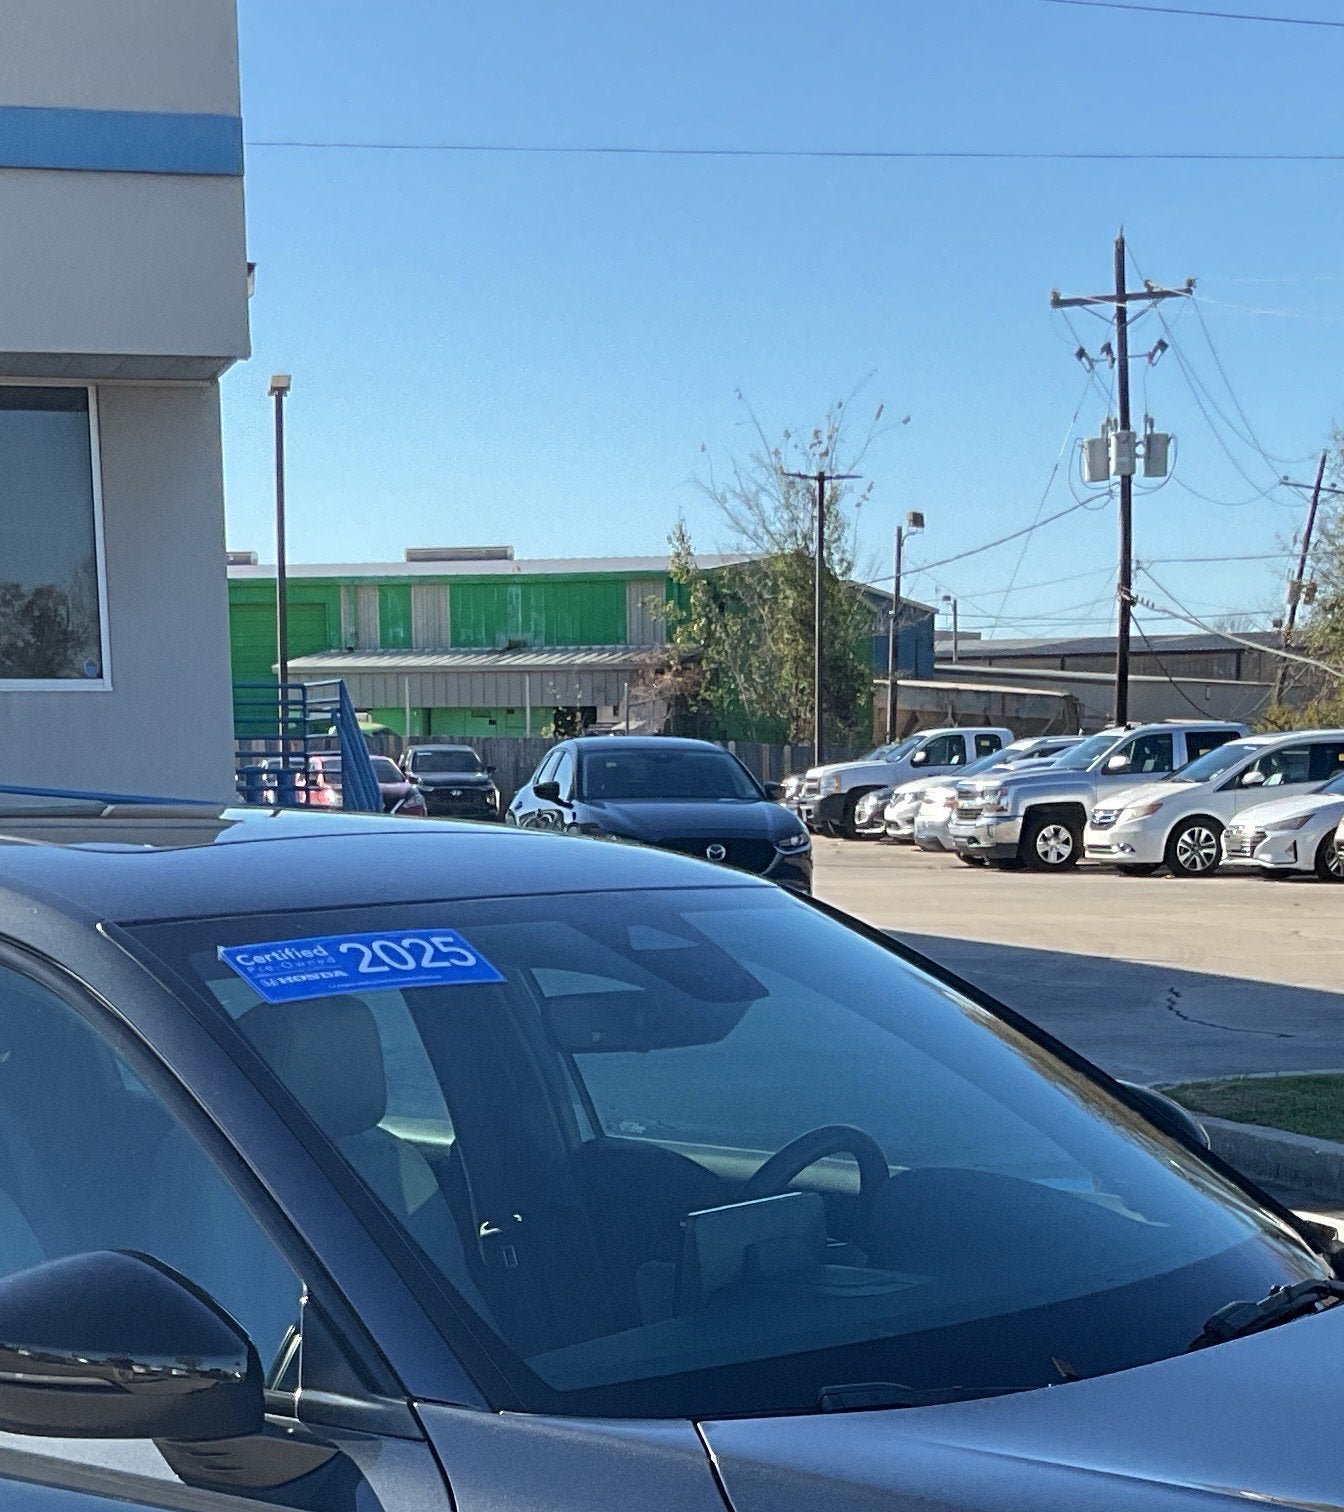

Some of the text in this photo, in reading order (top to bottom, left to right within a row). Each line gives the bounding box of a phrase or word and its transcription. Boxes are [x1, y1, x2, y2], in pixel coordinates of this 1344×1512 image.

[235, 936, 478, 974] Certified 2025
[276, 970, 349, 985] HONDA
